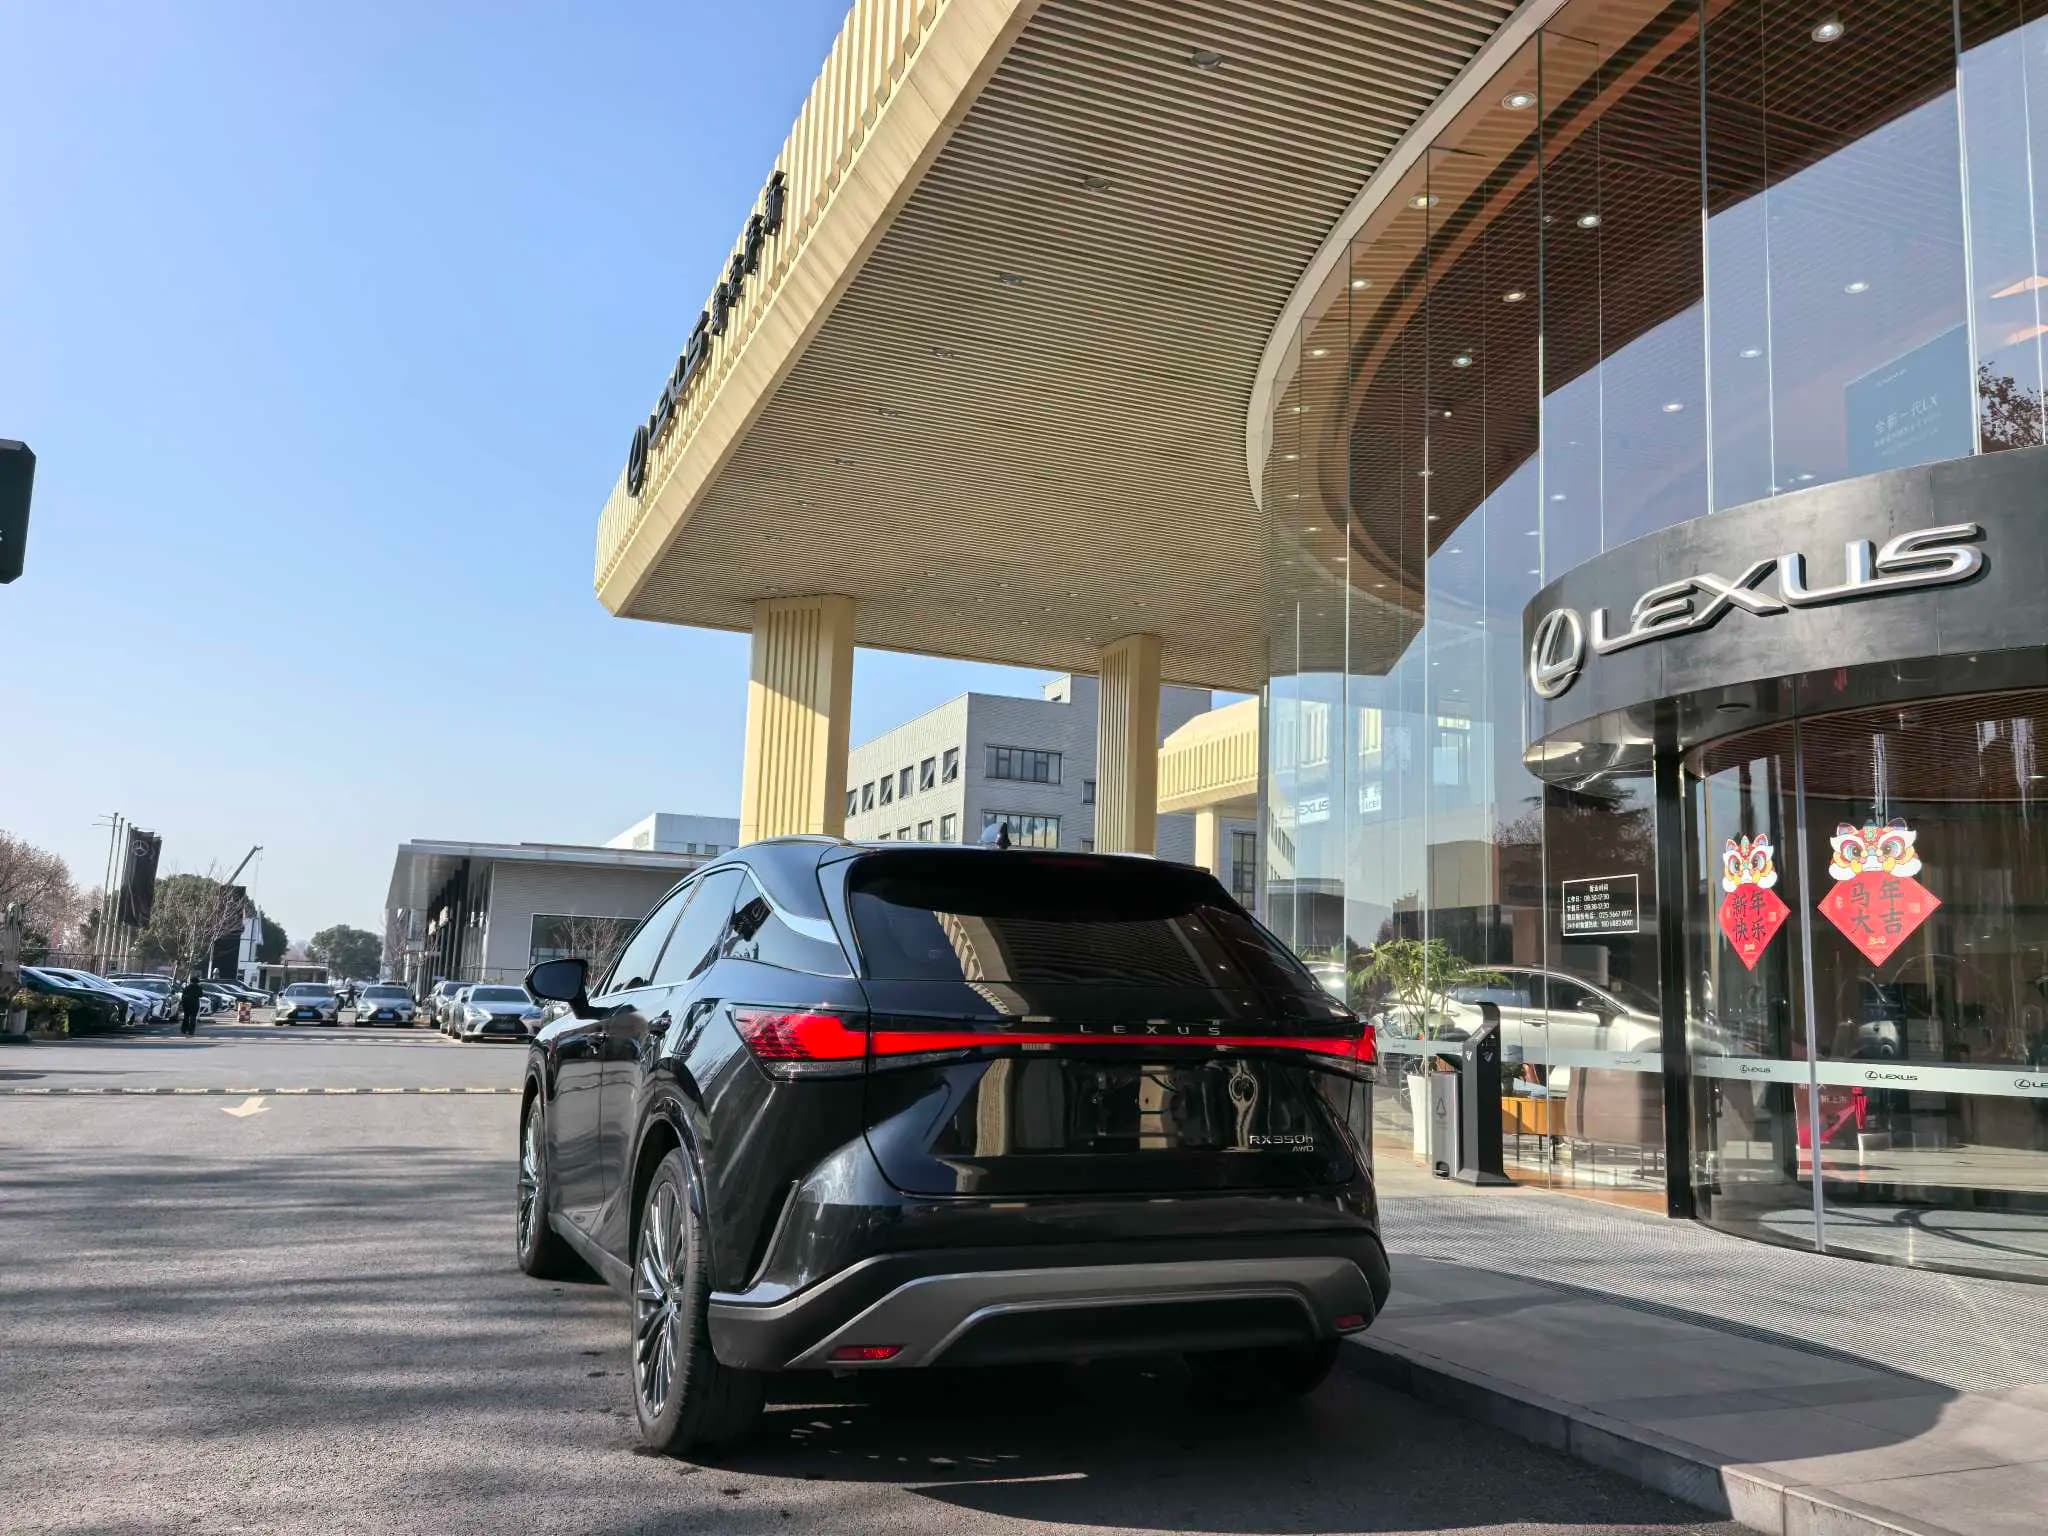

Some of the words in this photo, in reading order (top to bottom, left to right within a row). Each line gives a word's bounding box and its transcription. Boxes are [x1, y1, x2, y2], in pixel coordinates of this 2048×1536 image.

[1591, 522, 1986, 655] LEXUS
[1732, 890, 1767, 918] 新年
[1850, 879, 1905, 910] 马年
[1732, 917, 1767, 943] 快乐
[1850, 908, 1905, 935] 大吉
[1079, 1024, 1221, 1036] LEXUS
[1747, 1066, 1771, 1074] LEXUS
[1879, 1072, 1918, 1082] LEXUS
[1249, 1134, 1314, 1145] RX350h
[1291, 1145, 1314, 1153] AWD
